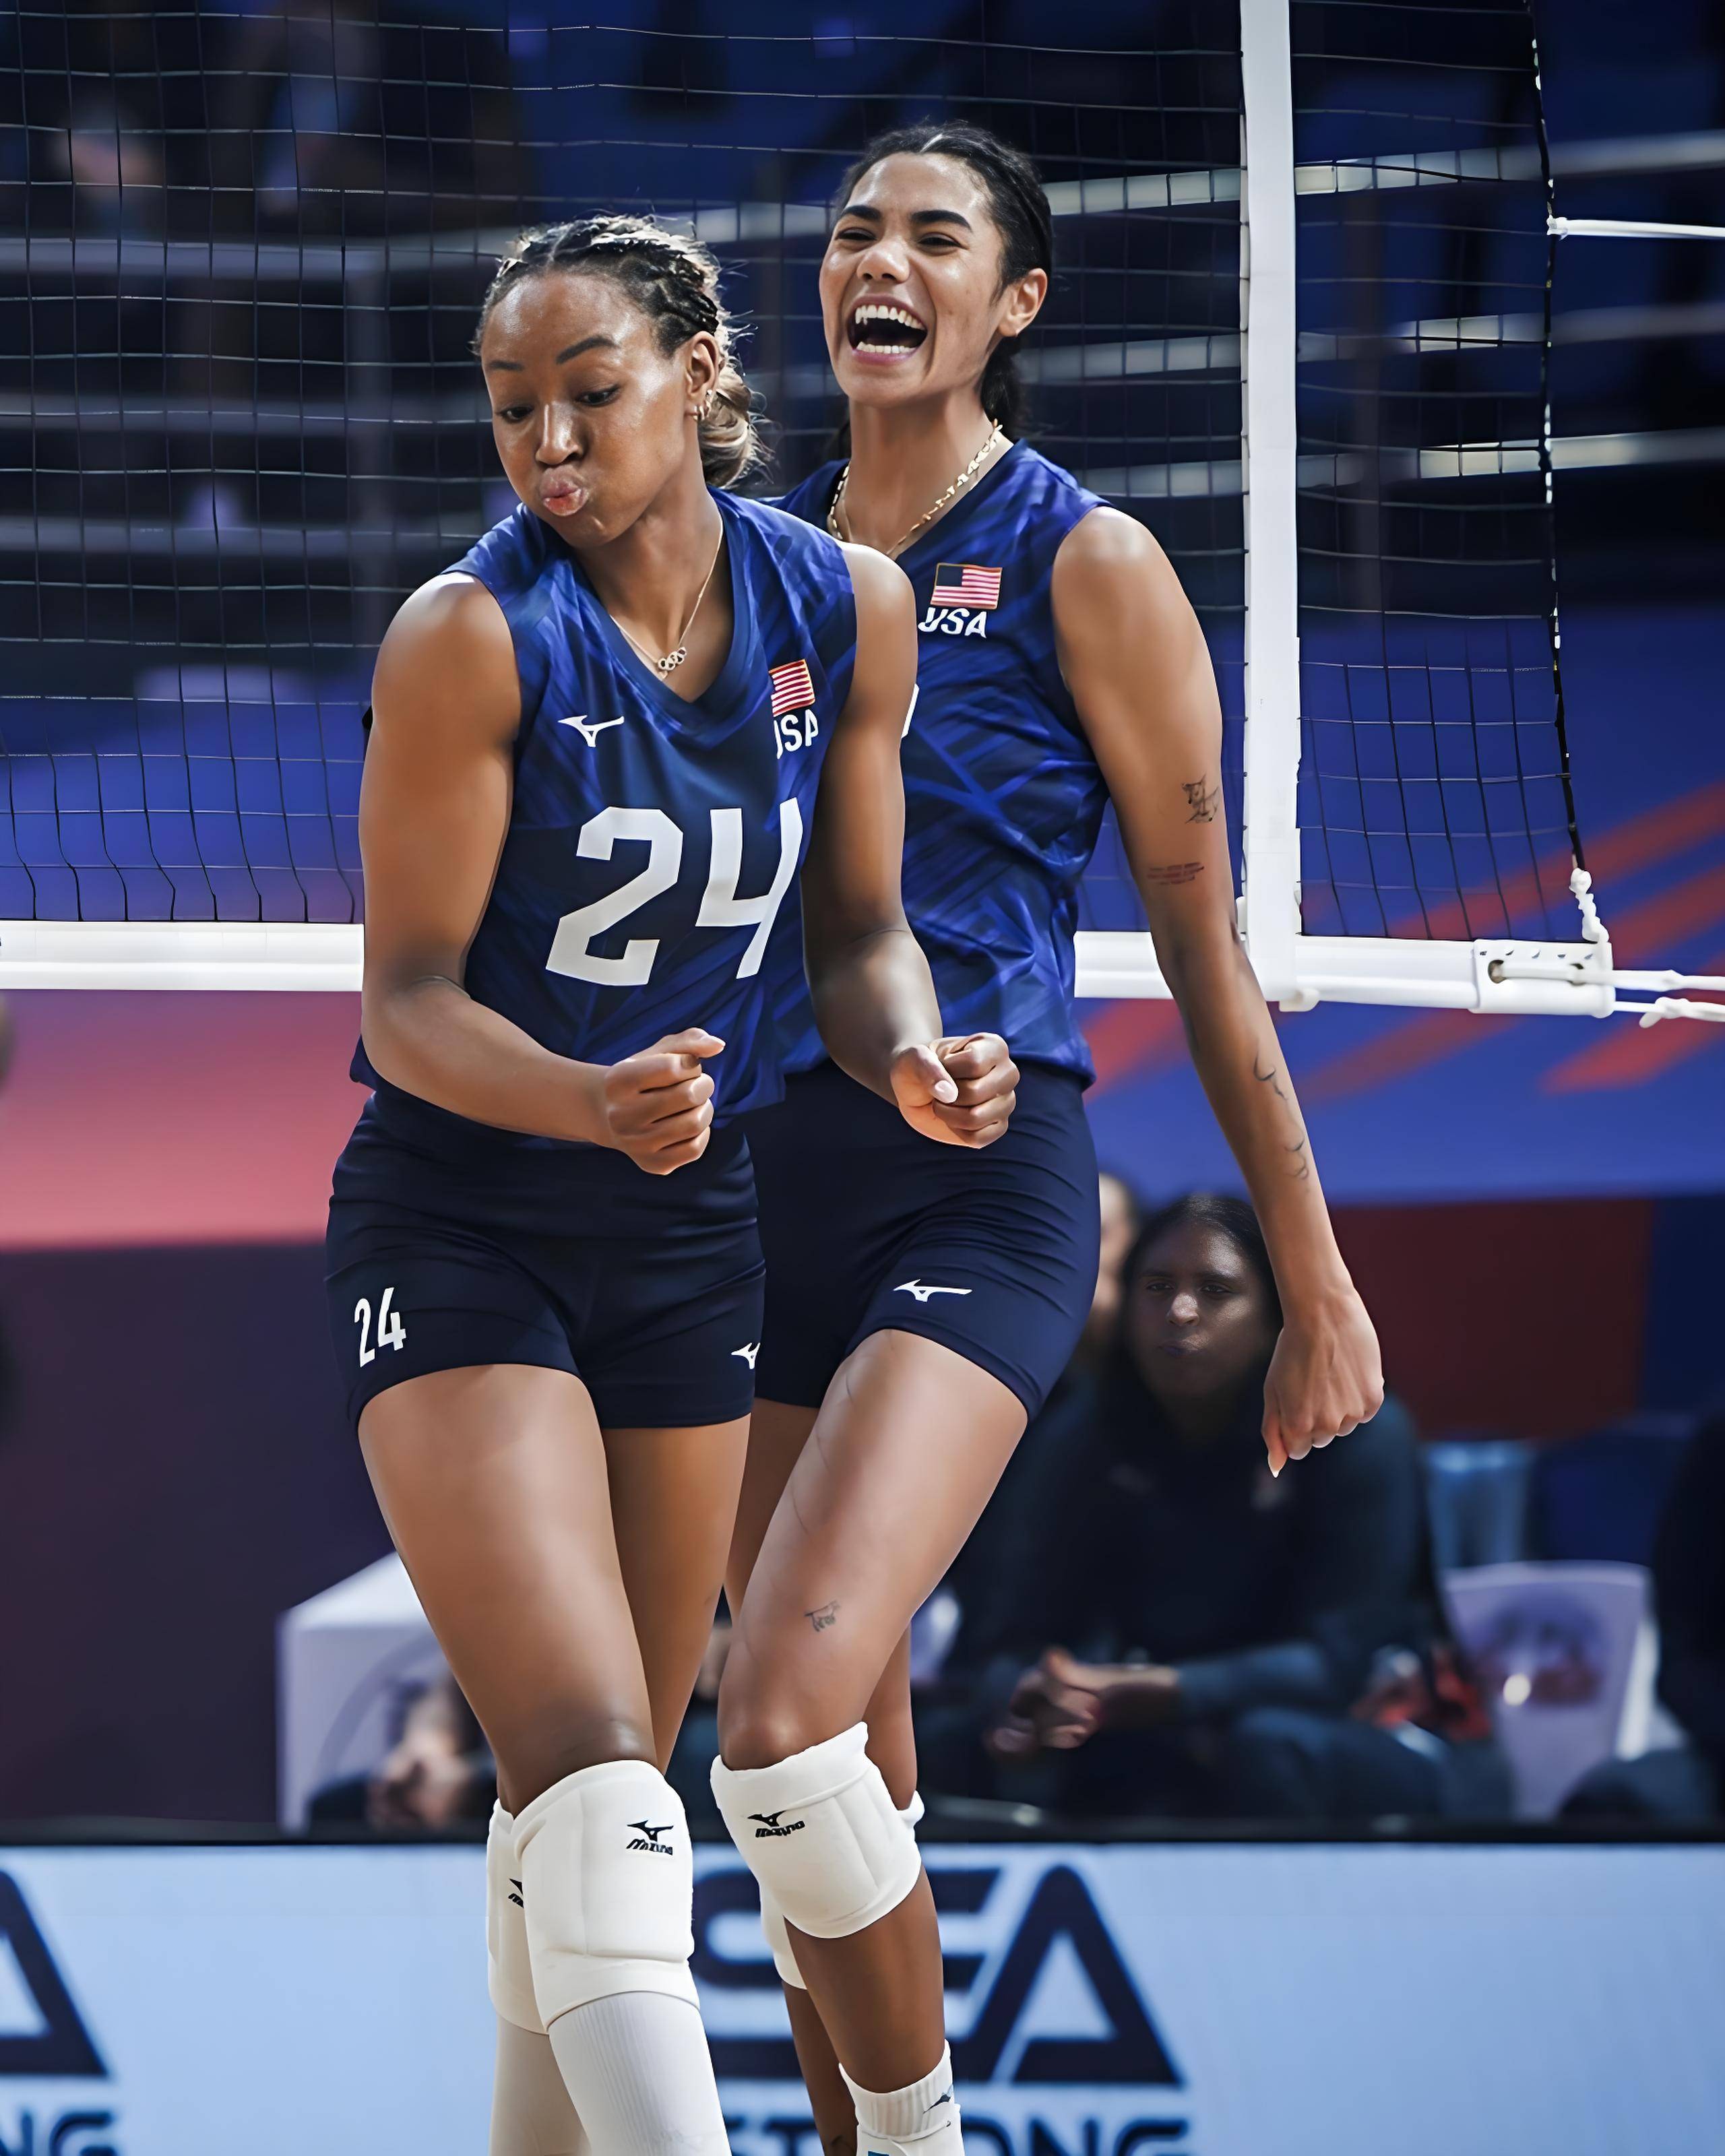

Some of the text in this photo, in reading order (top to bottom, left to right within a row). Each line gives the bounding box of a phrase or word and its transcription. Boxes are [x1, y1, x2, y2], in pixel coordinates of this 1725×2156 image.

[918, 607, 987, 639] USA
[546, 797, 803, 986] 24
[354, 1287, 406, 1368] 24
